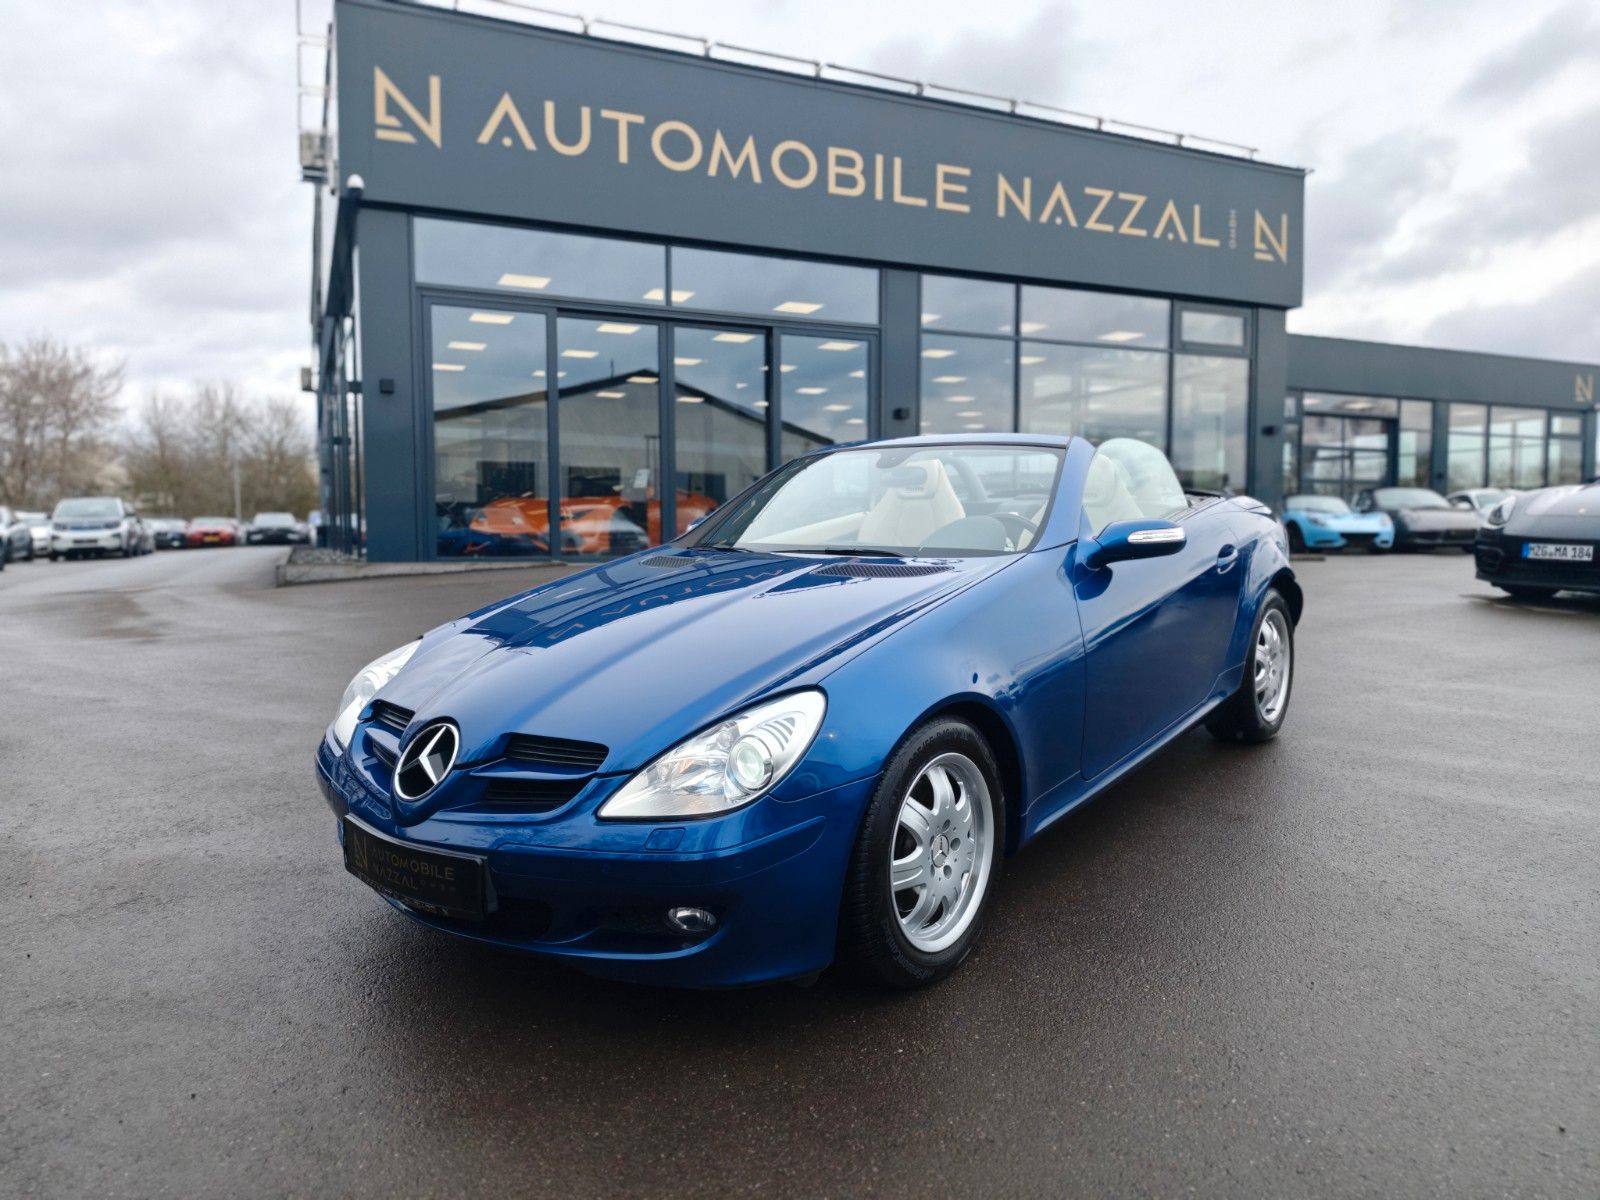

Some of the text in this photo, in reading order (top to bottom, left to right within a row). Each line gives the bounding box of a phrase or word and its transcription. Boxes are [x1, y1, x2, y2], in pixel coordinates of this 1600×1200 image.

[476, 91, 972, 213] AUTOMOBILE
[997, 172, 1221, 248] NAZZAL
[1571, 546, 1592, 559] 184
[372, 849, 455, 880] AUTOMOBILE
[372, 862, 419, 891] NAZZAL
